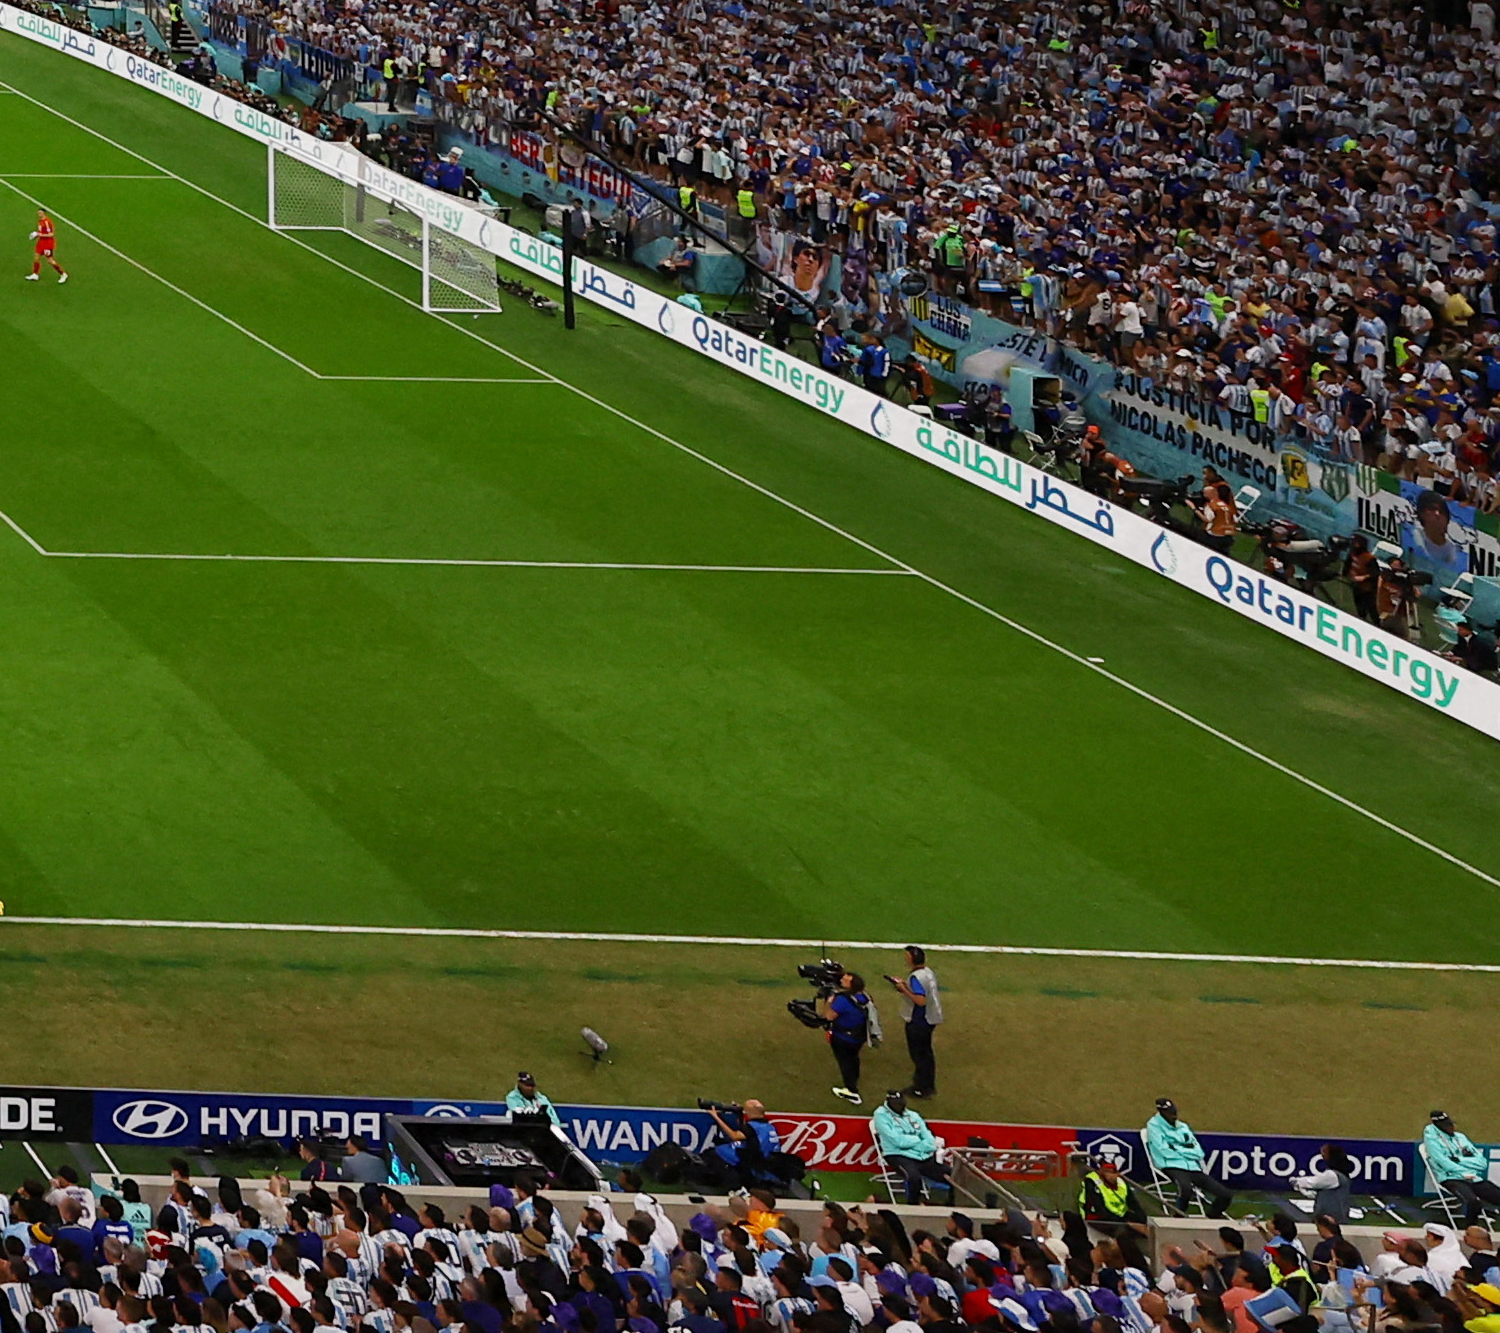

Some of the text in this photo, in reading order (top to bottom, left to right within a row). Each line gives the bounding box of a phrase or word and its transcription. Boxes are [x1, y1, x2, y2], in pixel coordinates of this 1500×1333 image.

[17, 16, 95, 56] قطر للطاقة
[127, 56, 201, 108] QatarEnergy
[579, 267, 635, 309] قطر
[693, 317, 844, 413] QatarEnergy
[1111, 399, 1278, 491] NICOLAS PACHECO
[1231, 411, 1278, 455] POR
[916, 419, 1111, 536] قطر للطاقة
[1206, 556, 1459, 708] QatarEnergy
